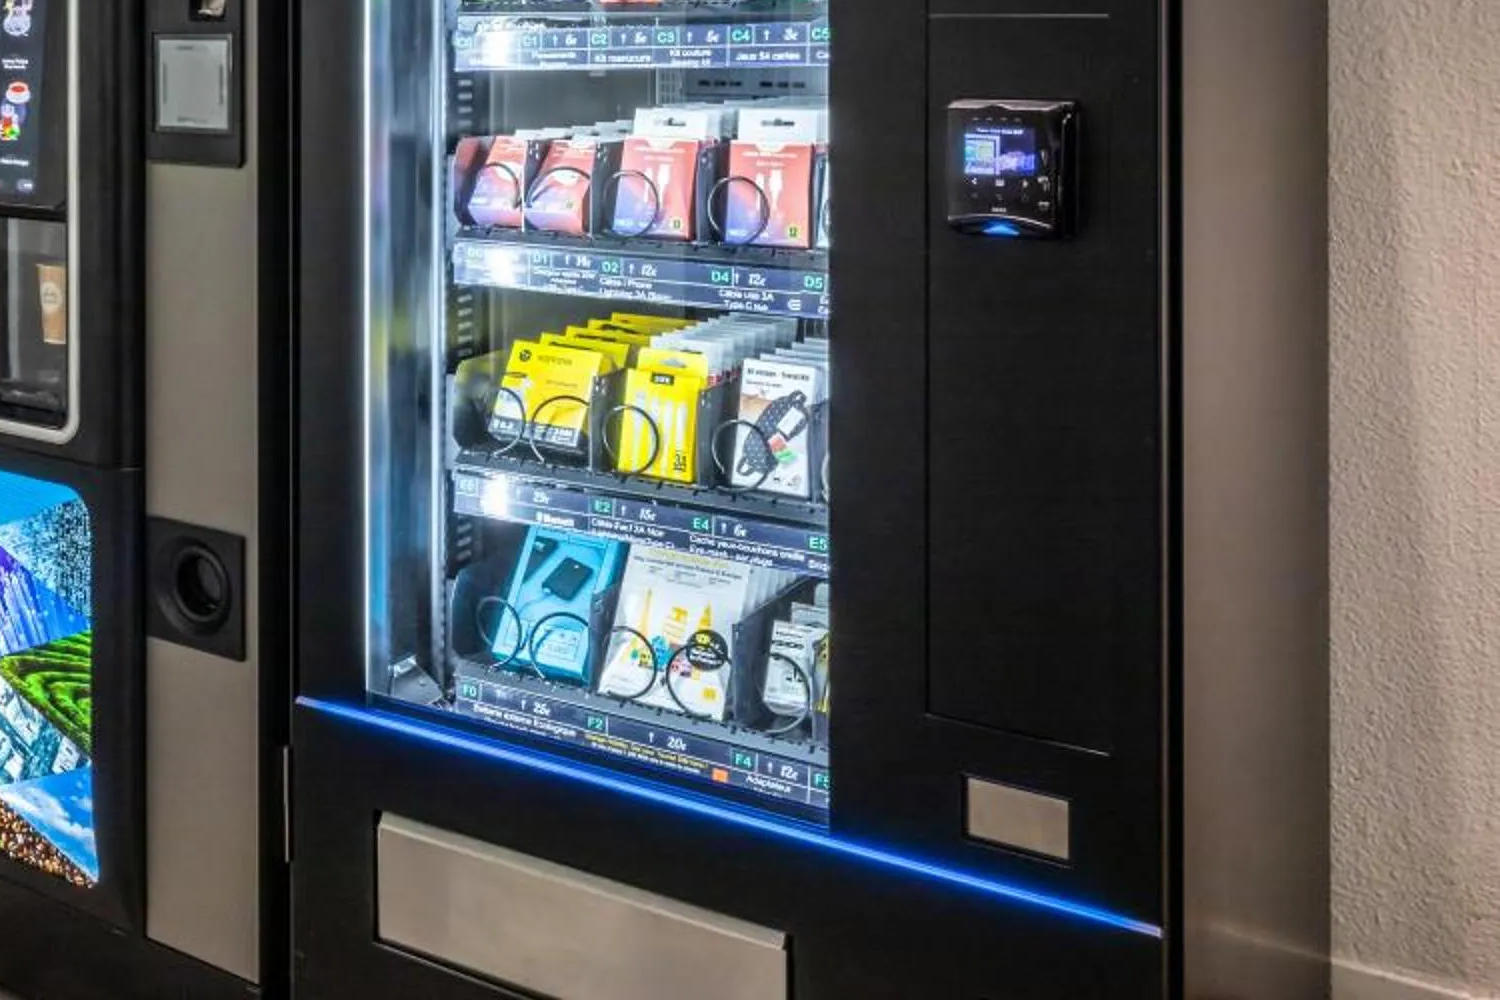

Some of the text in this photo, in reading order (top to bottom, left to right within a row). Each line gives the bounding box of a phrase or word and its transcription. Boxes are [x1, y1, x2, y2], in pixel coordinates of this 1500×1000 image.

[657, 31, 676, 43] C3
[732, 29, 750, 41] C4
[711, 270, 729, 283] D4
[804, 276, 823, 289] D5
[692, 518, 710, 530] E4
[735, 753, 752, 769] F4
